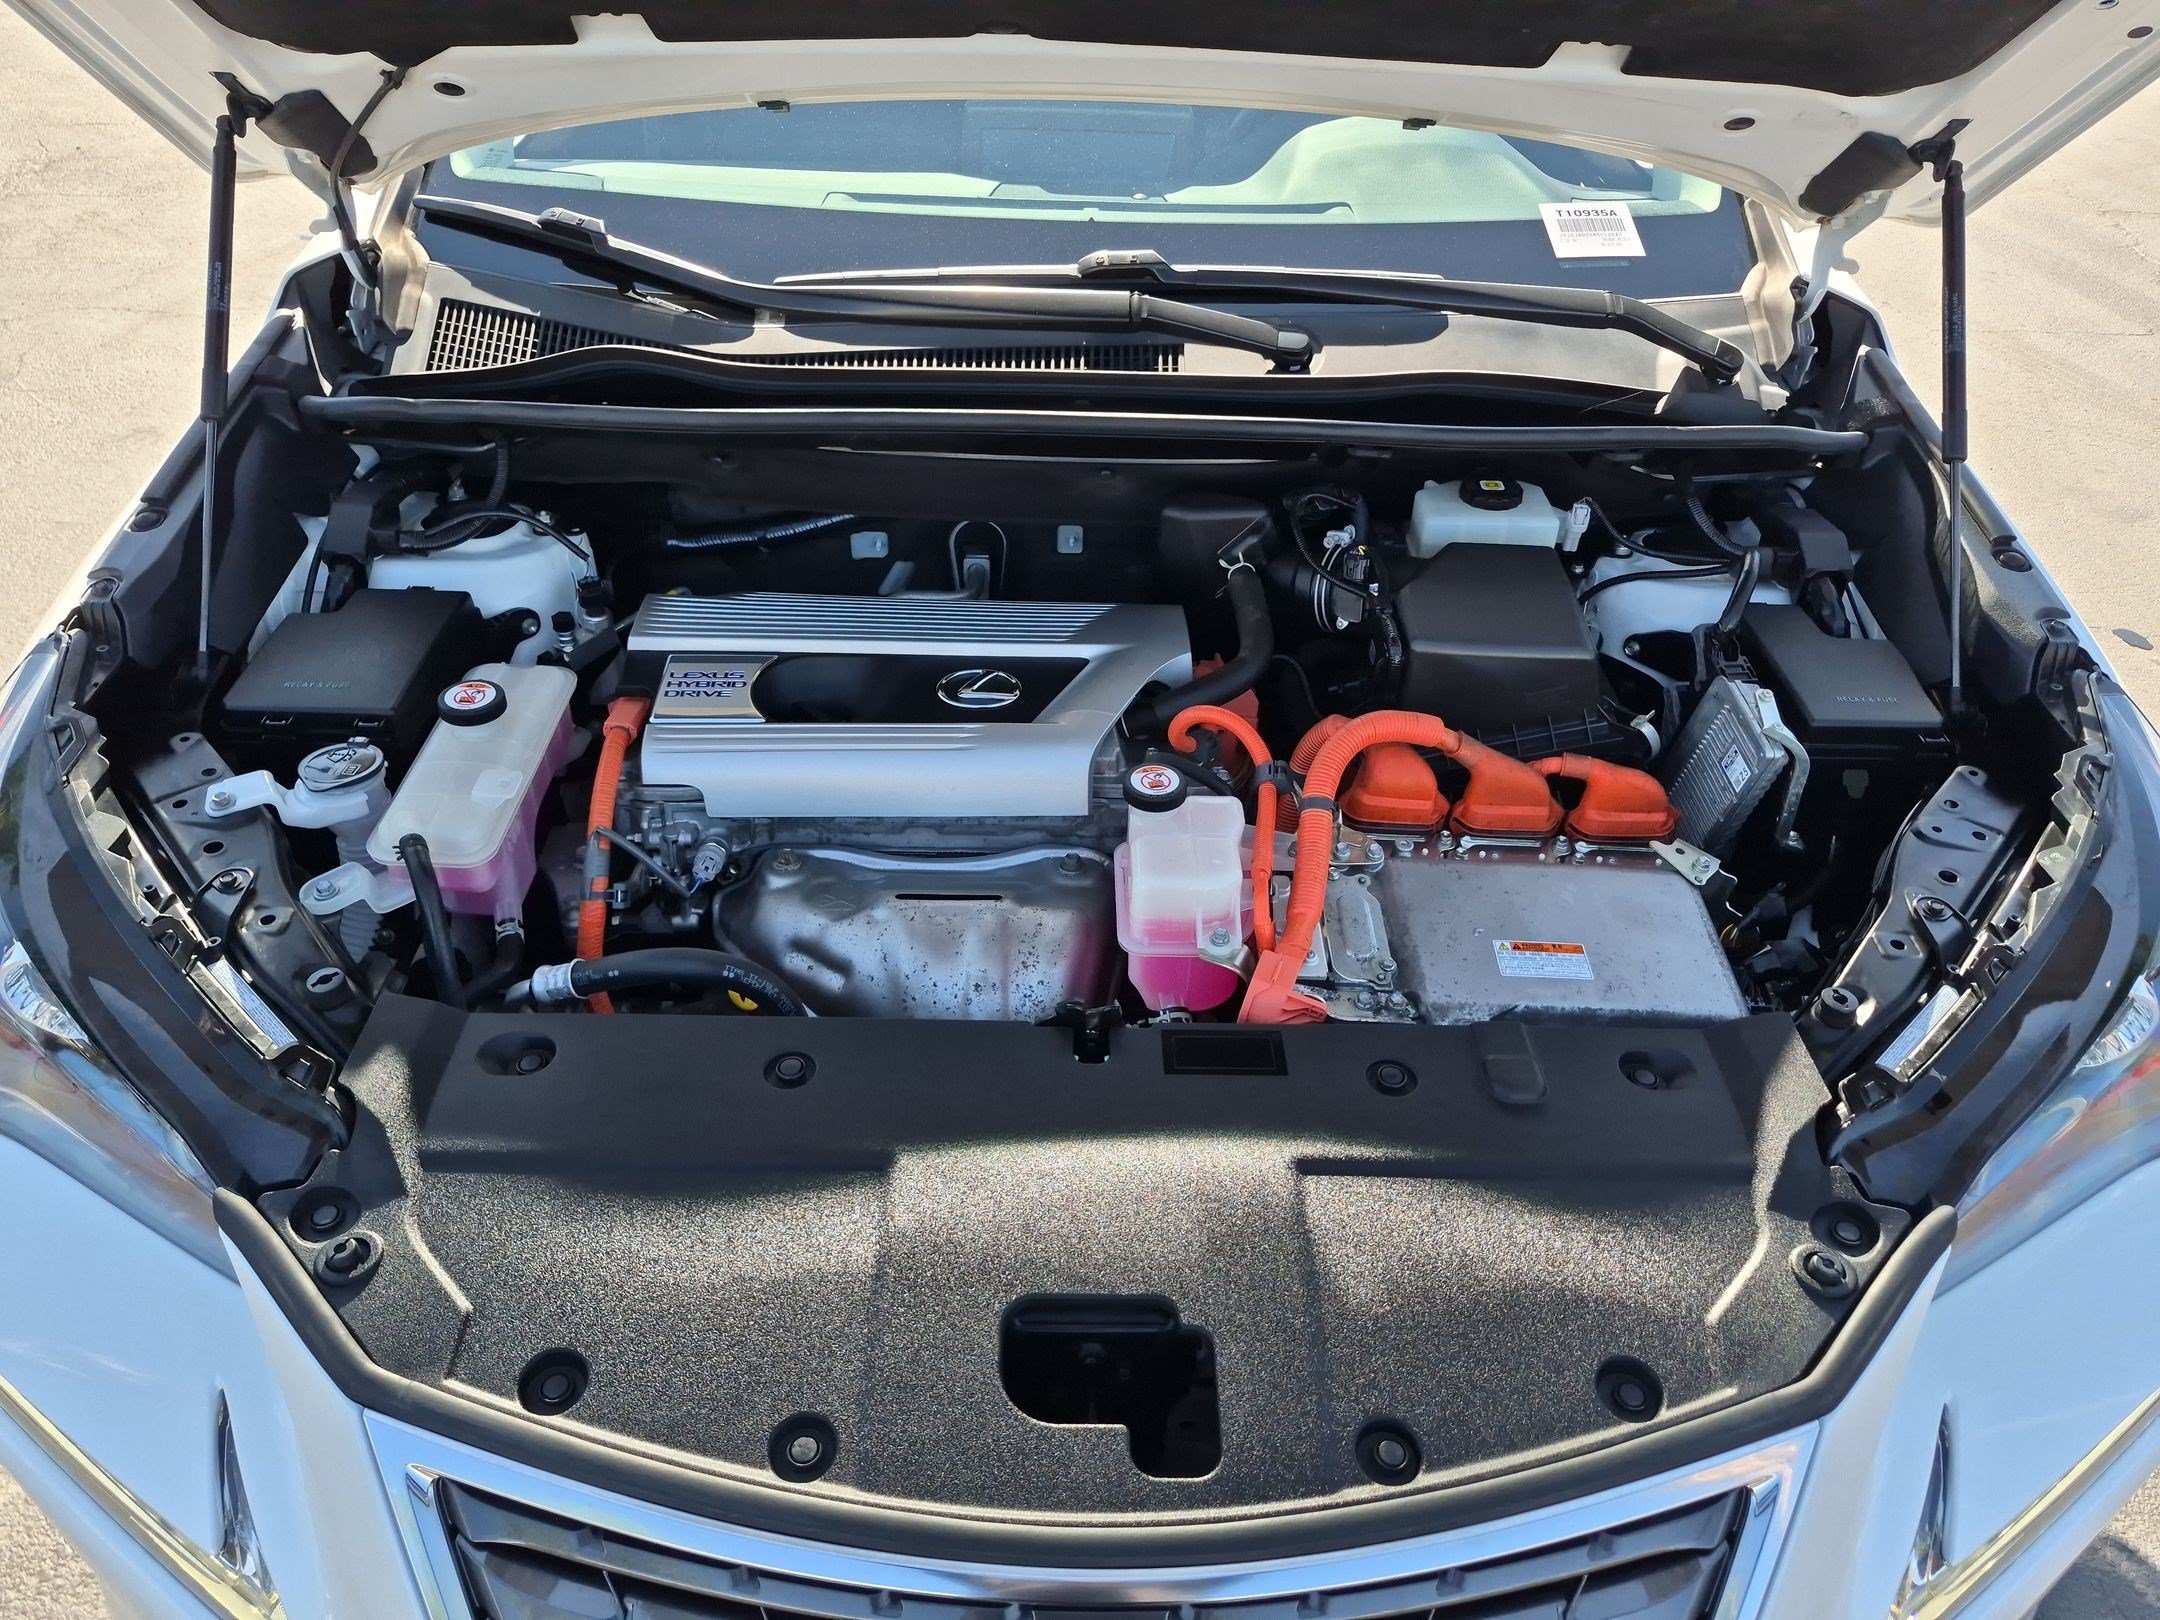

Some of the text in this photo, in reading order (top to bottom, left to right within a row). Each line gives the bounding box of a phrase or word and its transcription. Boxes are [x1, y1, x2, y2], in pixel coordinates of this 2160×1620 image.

[1555, 209, 1618, 218] T10935A
[669, 671, 745, 679] LEXUS
[666, 680, 748, 688] HYBRID
[663, 689, 732, 698] DRIVE
